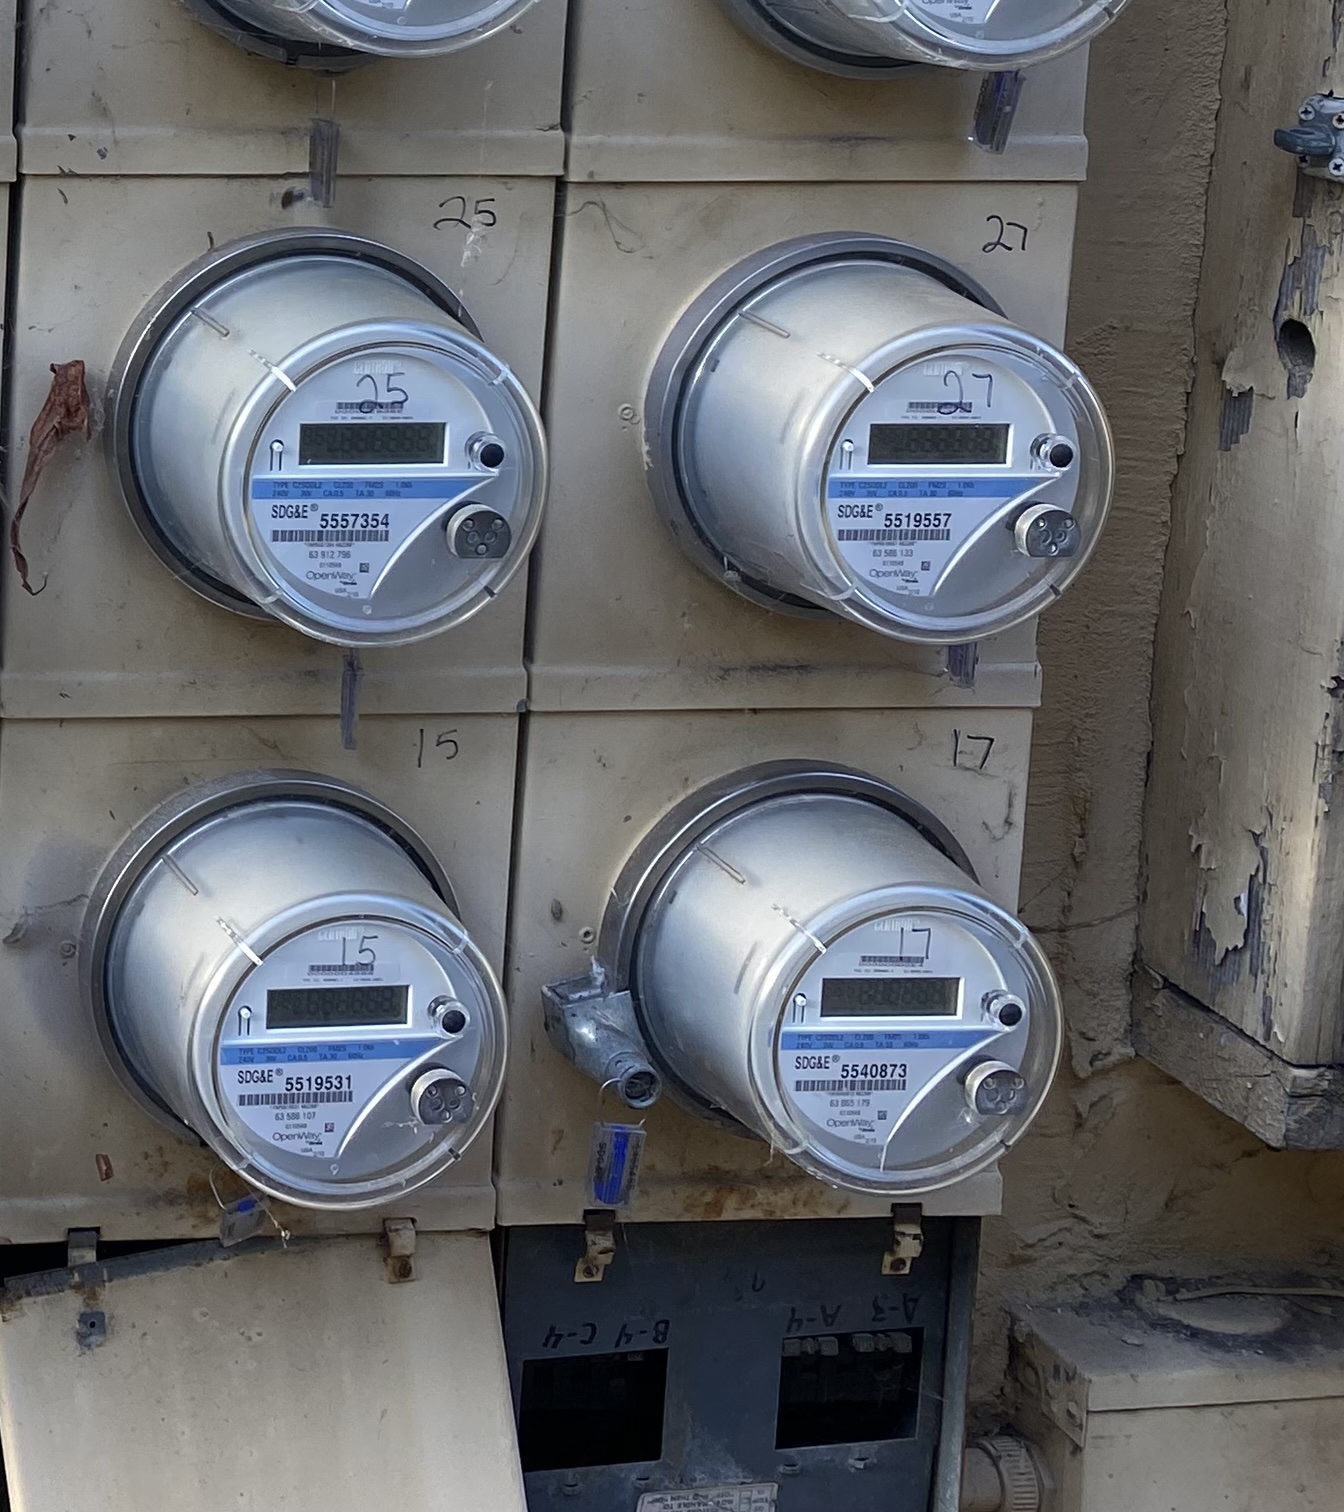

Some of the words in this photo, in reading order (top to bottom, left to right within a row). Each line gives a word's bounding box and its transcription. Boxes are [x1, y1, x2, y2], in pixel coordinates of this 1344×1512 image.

[433, 195, 496, 230] 25
[982, 214, 1028, 254] 27
[356, 372, 409, 414] 25
[936, 370, 993, 415] 27
[319, 513, 390, 529] 5557354
[884, 512, 952, 528] 5519557
[306, 570, 356, 582] OpenWay
[869, 568, 918, 580] OpenWay
[418, 728, 459, 768] 15
[953, 728, 994, 770] 17
[341, 935, 379, 967] 15
[899, 926, 932, 961] 17
[284, 1074, 352, 1093] 5519531
[840, 1063, 907, 1079] 5540873
[272, 1132, 323, 1142] OpenWay
[826, 1118, 876, 1129] OpenWay
[541, 1321, 599, 1350] C-4
[613, 1318, 671, 1347] B-4
